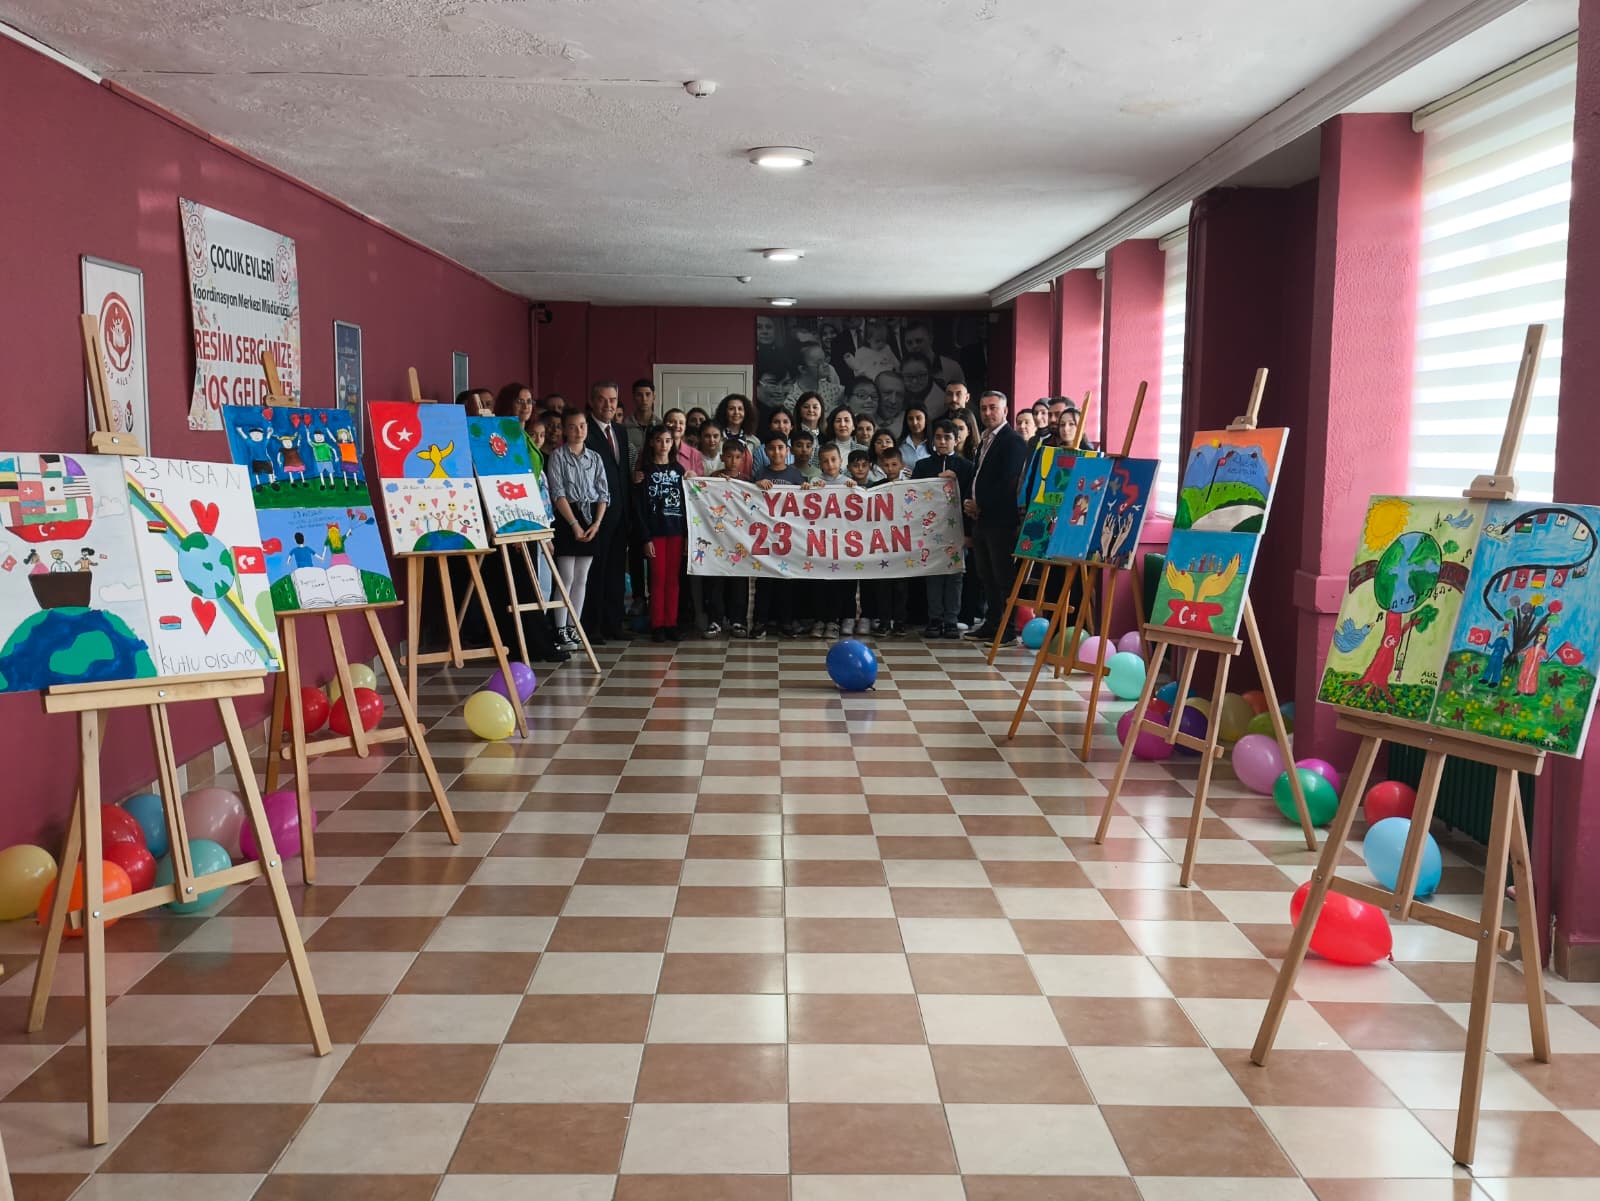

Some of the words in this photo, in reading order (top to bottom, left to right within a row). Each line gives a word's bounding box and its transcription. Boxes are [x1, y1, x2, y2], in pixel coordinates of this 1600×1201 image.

[210, 244, 244, 273] ÇOCUK
[245, 254, 275, 282] EVLERİ
[193, 282, 238, 309] Koordinasyon
[238, 293, 262, 312] Merkezi
[194, 325, 233, 362] RESİM
[130, 458, 159, 479] 23
[762, 491, 894, 525] YAŞASIN
[749, 521, 792, 556] 23
[806, 525, 912, 560] NİSAN
